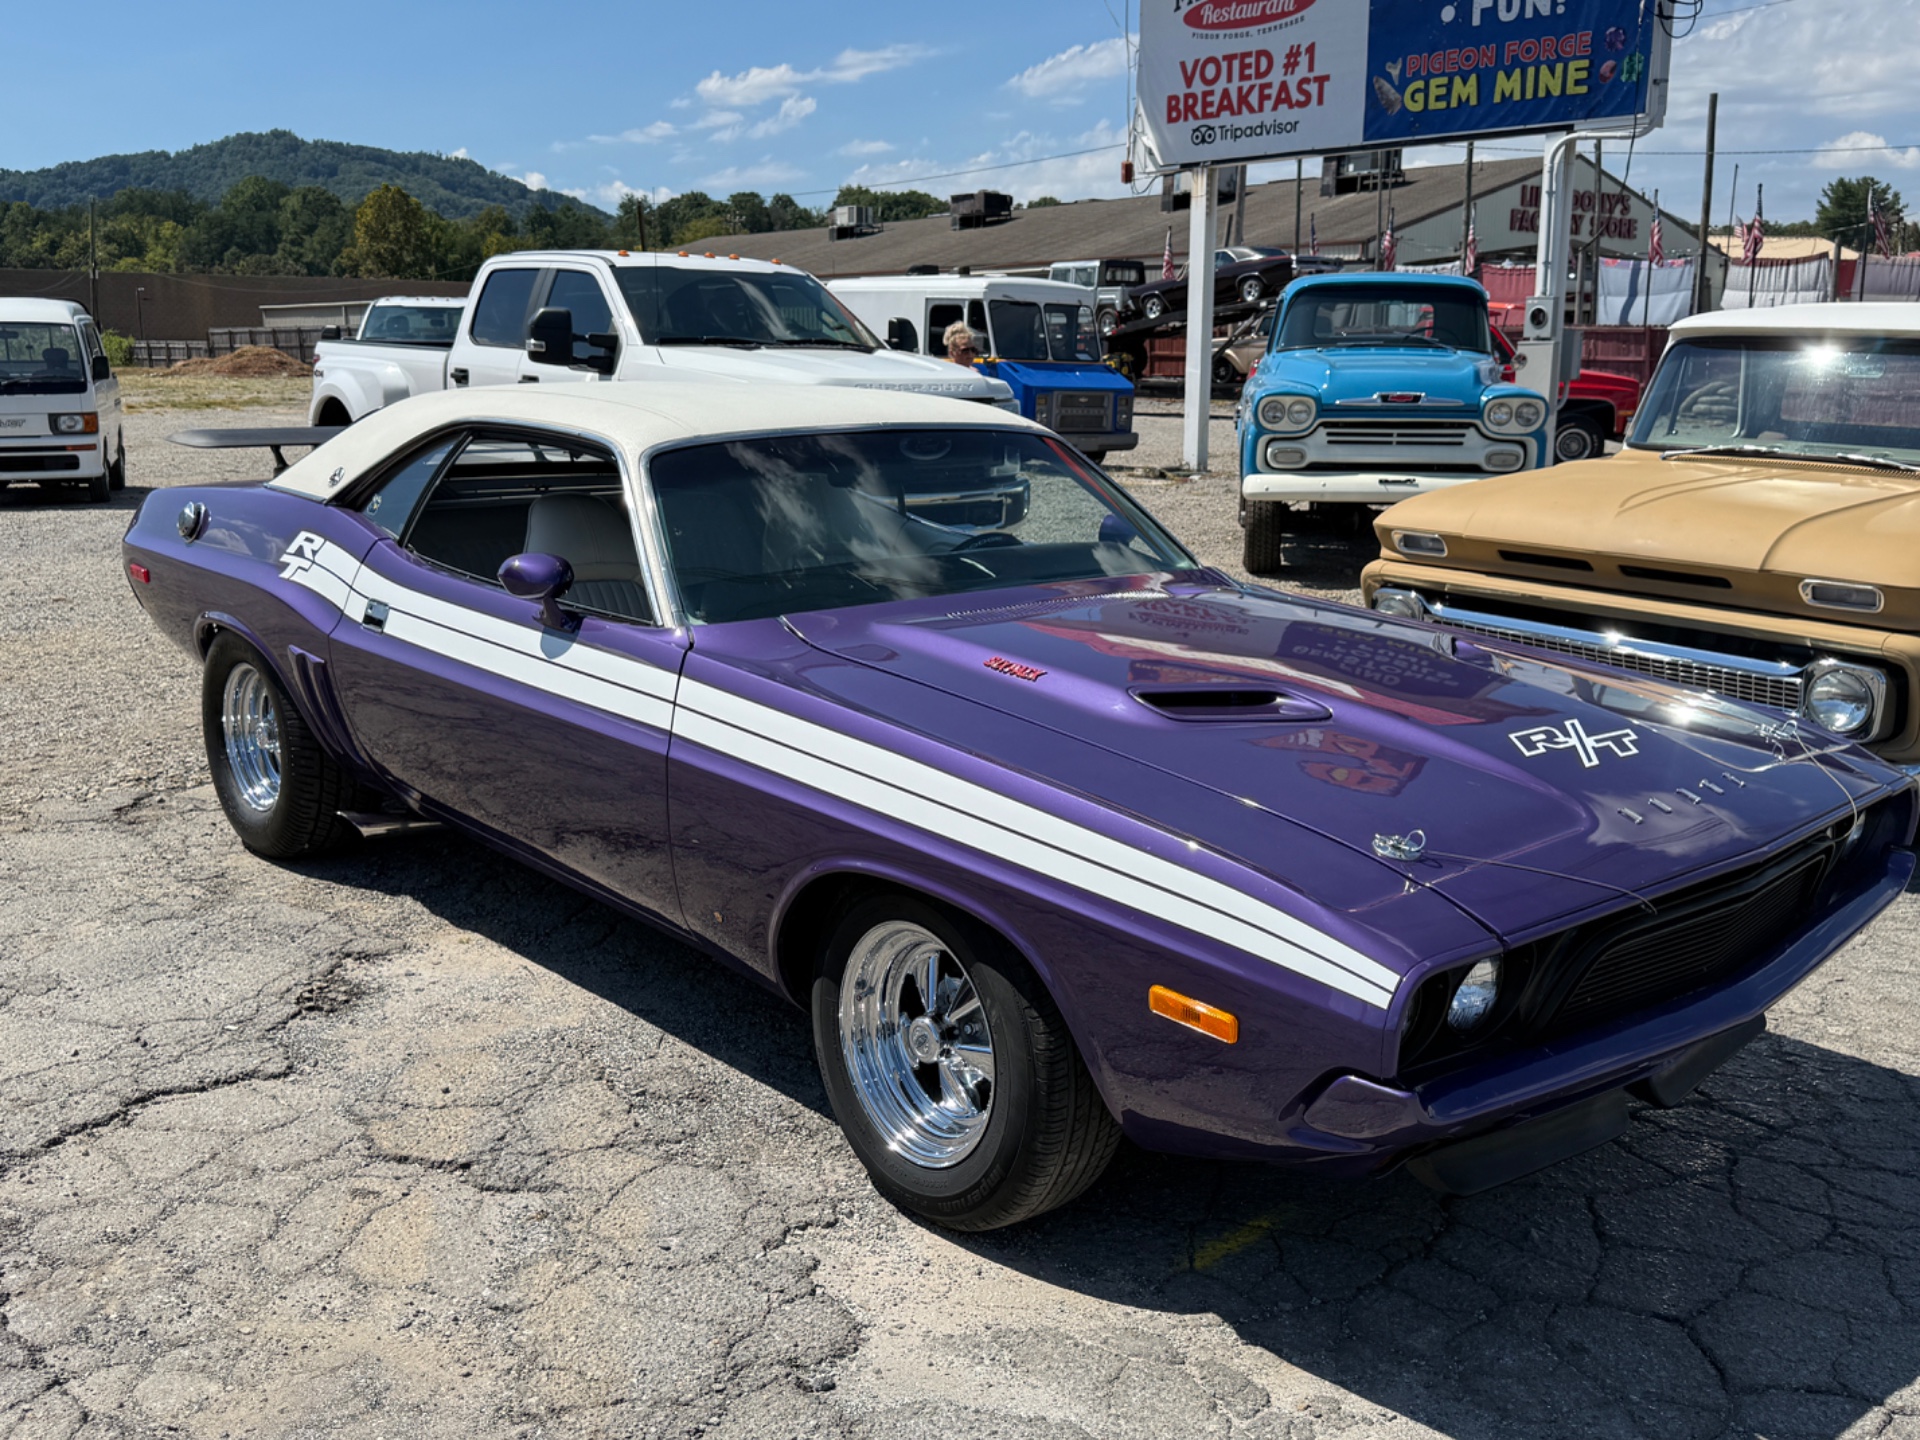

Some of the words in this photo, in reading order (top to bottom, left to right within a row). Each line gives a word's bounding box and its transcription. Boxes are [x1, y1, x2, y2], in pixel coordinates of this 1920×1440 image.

[1200, 0, 1297, 25] Restaurant
[1192, 32, 1220, 40] PIGEON
[1406, 44, 1496, 77] PIGEON
[1504, 31, 1593, 66] FORGE
[1179, 49, 1274, 89] VOTED
[1282, 41, 1316, 77] #1
[1403, 73, 1478, 112] GEM
[1493, 59, 1590, 104] MINE
[1166, 74, 1331, 124] BREAKFAST
[1218, 119, 1299, 142] Tripadvisor
[1509, 208, 1585, 236] FACY
[1508, 718, 1639, 768] R/T
